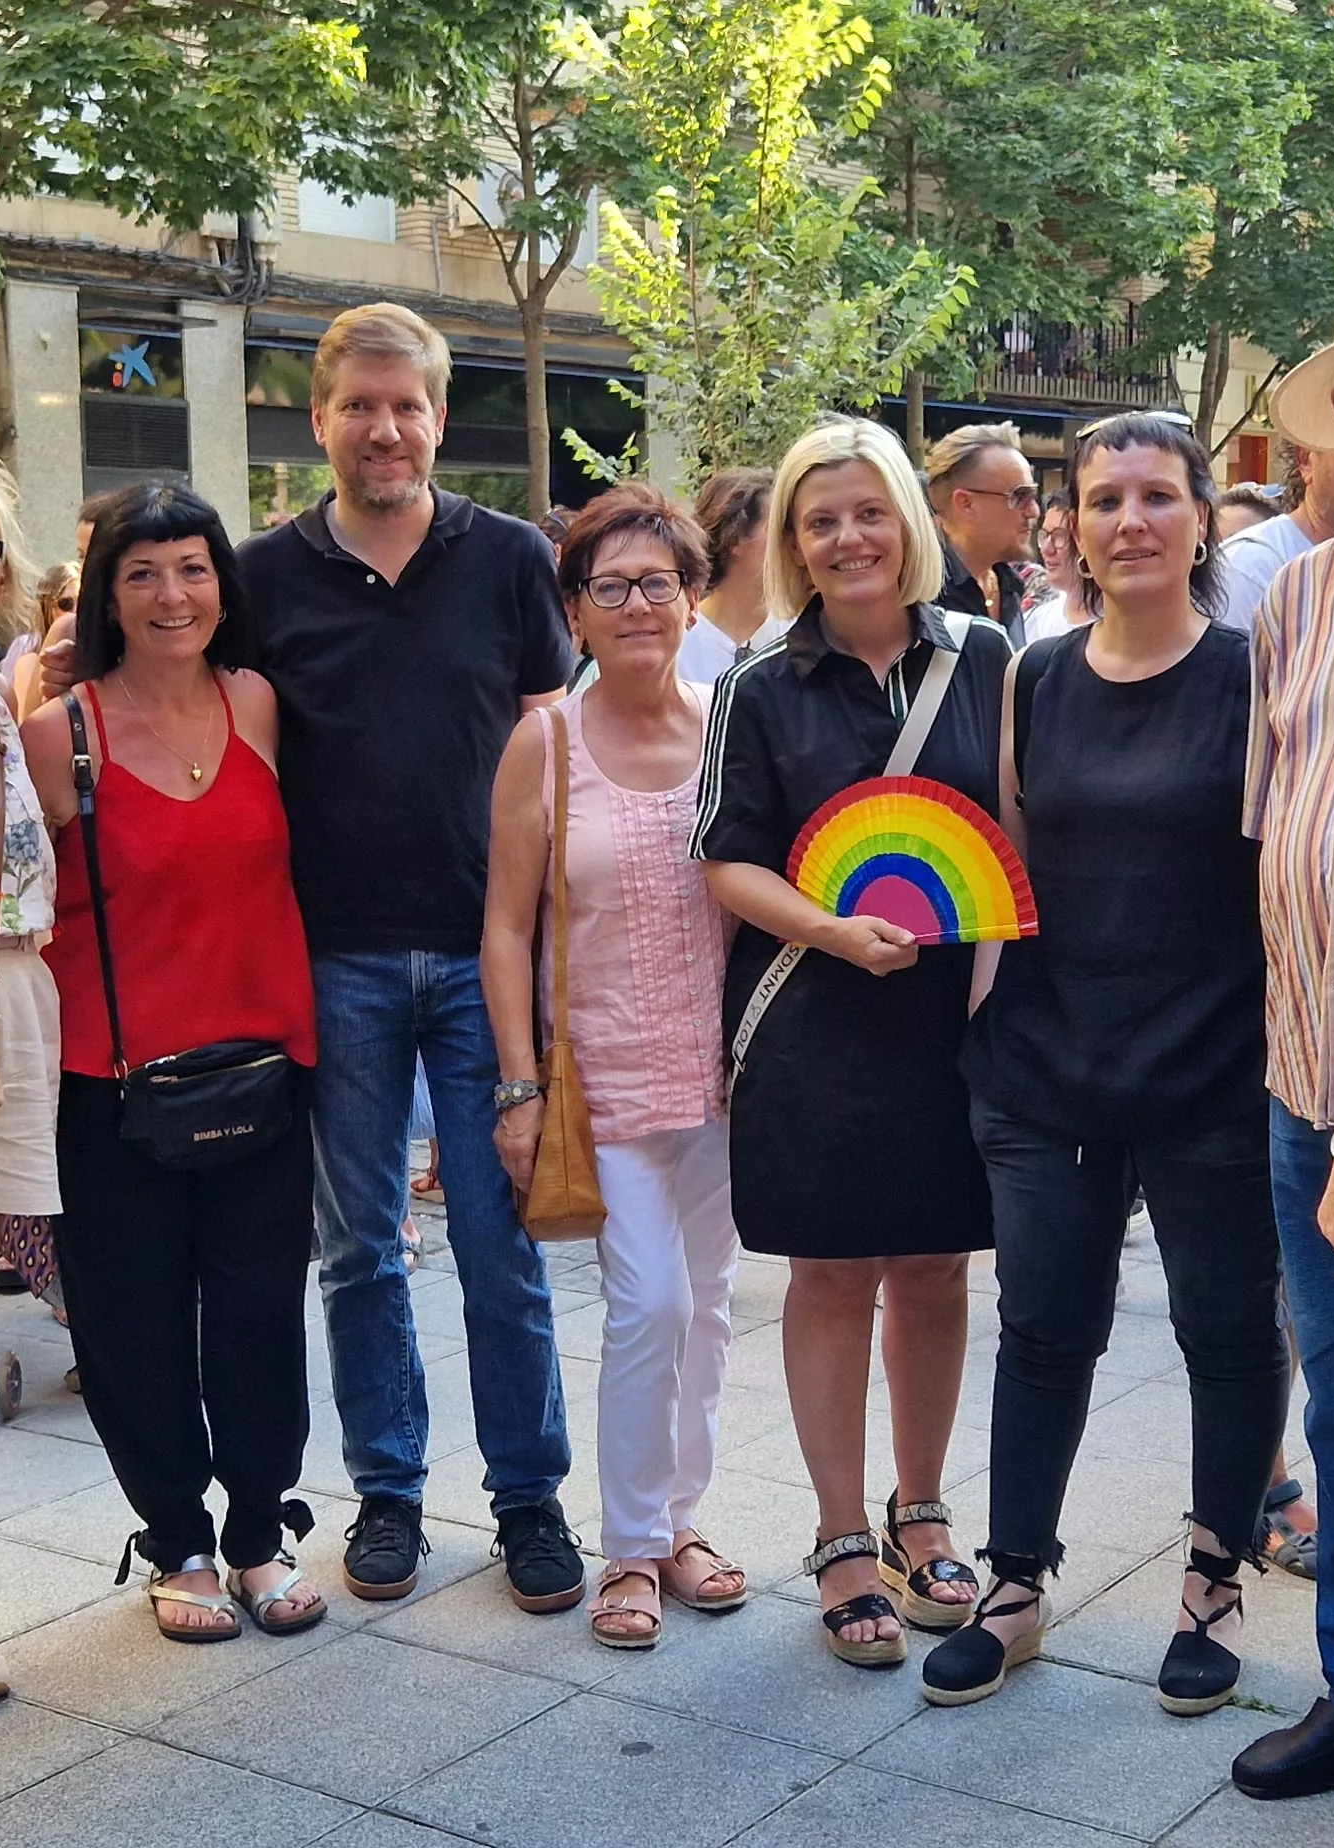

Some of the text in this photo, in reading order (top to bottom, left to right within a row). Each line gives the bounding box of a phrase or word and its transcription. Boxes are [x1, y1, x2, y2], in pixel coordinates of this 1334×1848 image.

[193, 1124, 255, 1142] BIMBA Y LOLA
